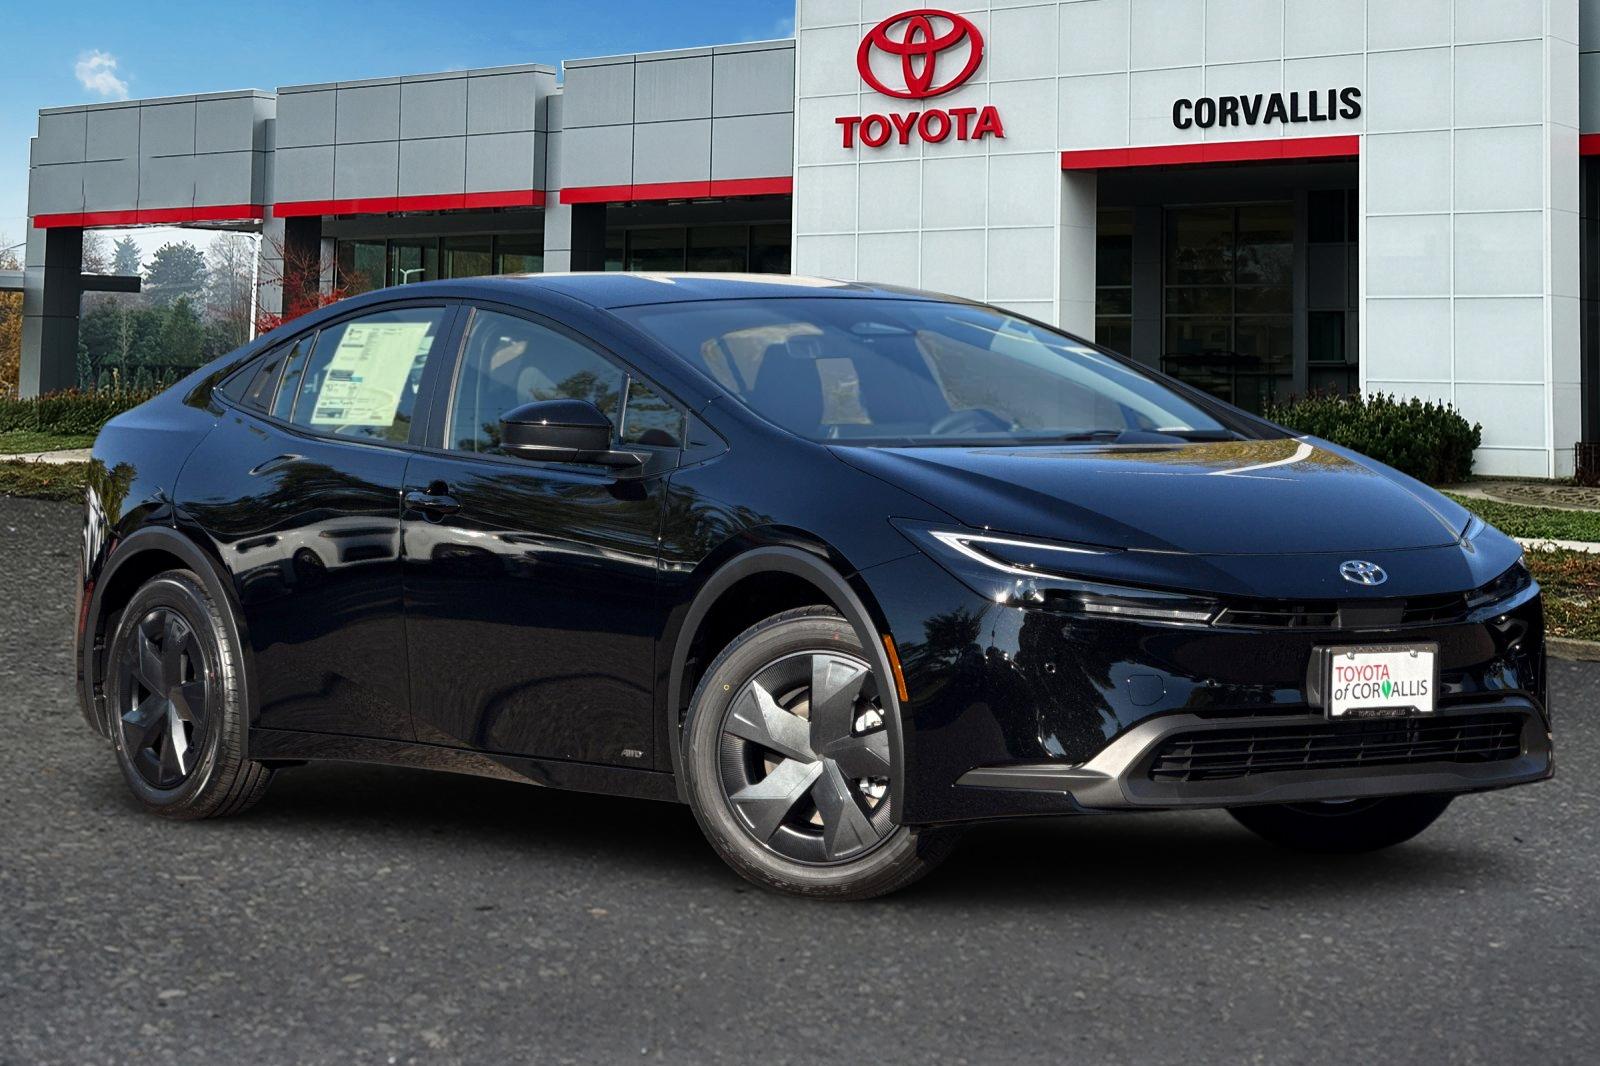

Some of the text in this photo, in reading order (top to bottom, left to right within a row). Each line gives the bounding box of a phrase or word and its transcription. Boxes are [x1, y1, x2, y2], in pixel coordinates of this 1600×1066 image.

[1172, 87, 1361, 129] CORVALLIS
[835, 106, 1004, 148] TOYOTA
[1335, 664, 1390, 683] TOYOTA
[1334, 683, 1349, 701] of
